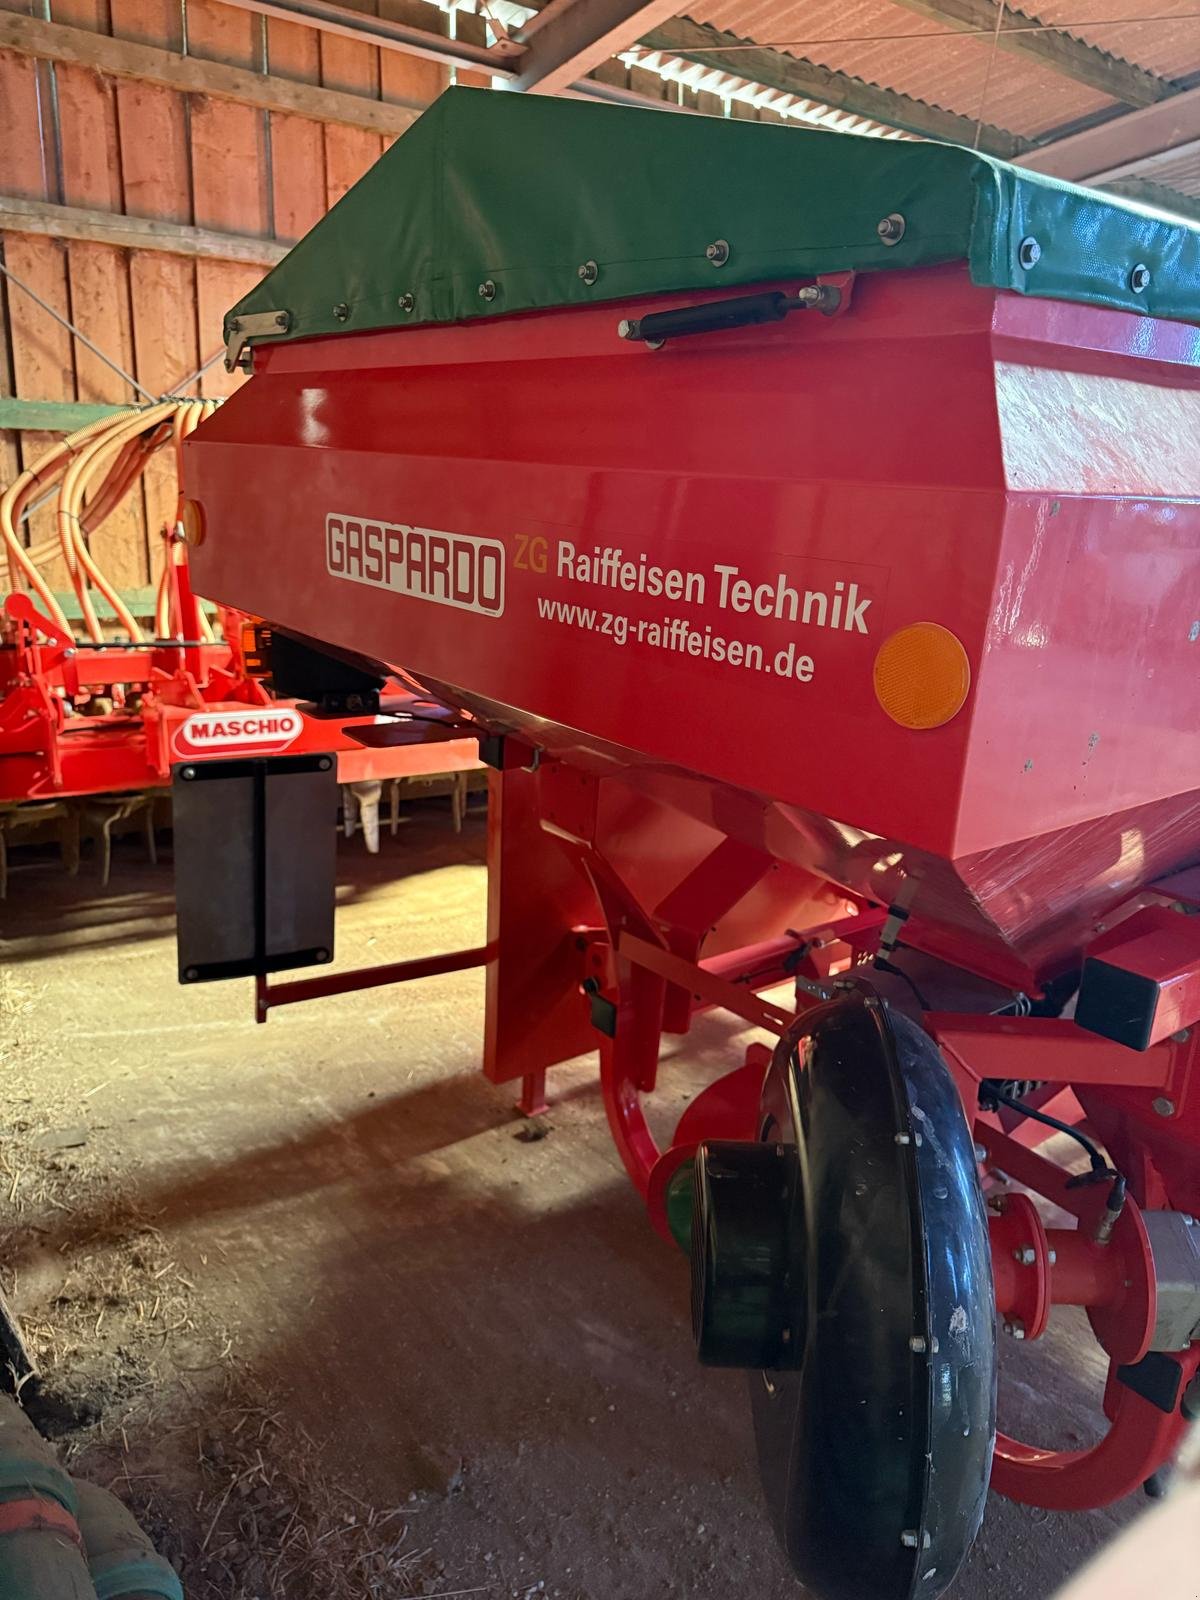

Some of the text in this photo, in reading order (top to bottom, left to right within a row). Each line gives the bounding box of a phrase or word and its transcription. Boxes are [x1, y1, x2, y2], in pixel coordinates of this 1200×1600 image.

[328, 518, 501, 611] GASPARDO
[512, 533, 872, 634] ZG Raiffeisen Technik
[537, 597, 815, 682] www.zg-raiffeisen.de
[191, 718, 294, 739] MASCHIO
